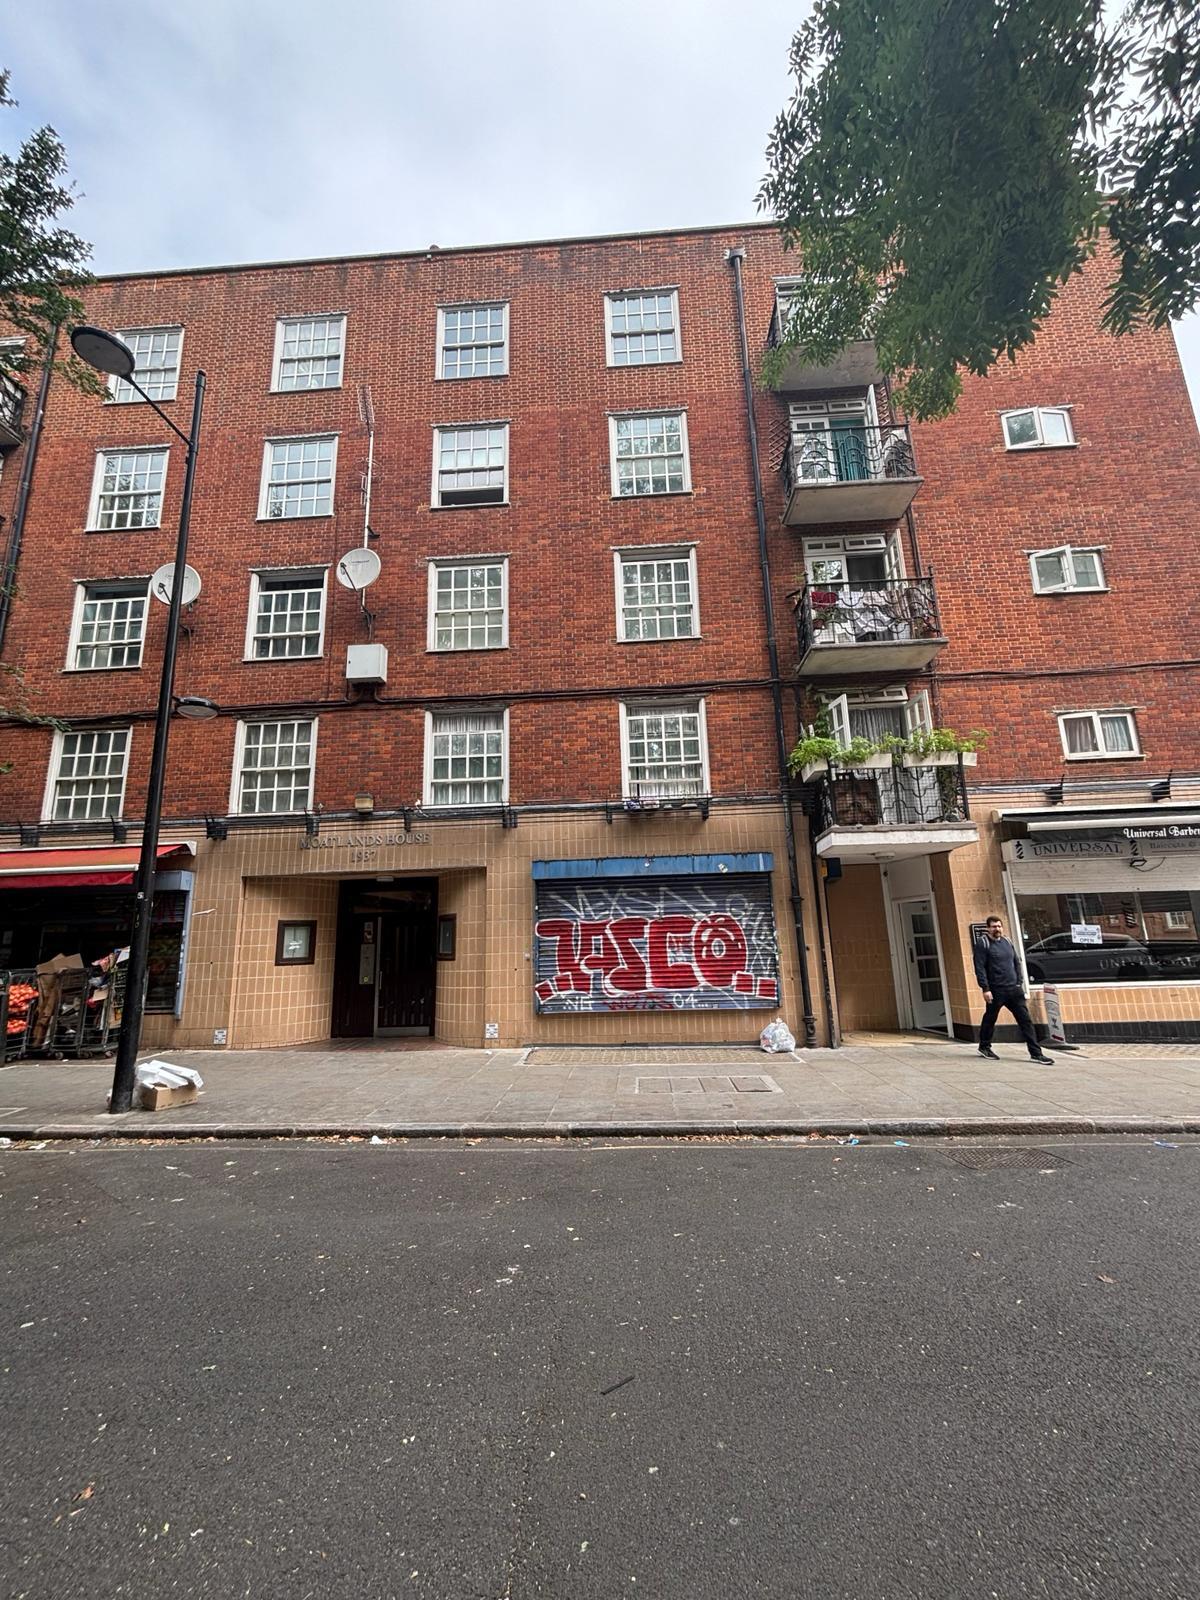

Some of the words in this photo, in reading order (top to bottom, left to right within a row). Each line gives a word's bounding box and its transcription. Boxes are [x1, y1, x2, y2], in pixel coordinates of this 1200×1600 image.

[1123, 827, 1167, 838] Universal
[300, 835, 383, 850] MOATLANDS
[385, 833, 432, 845] HOUSE
[1033, 842, 1123, 856] UNIVERSAL
